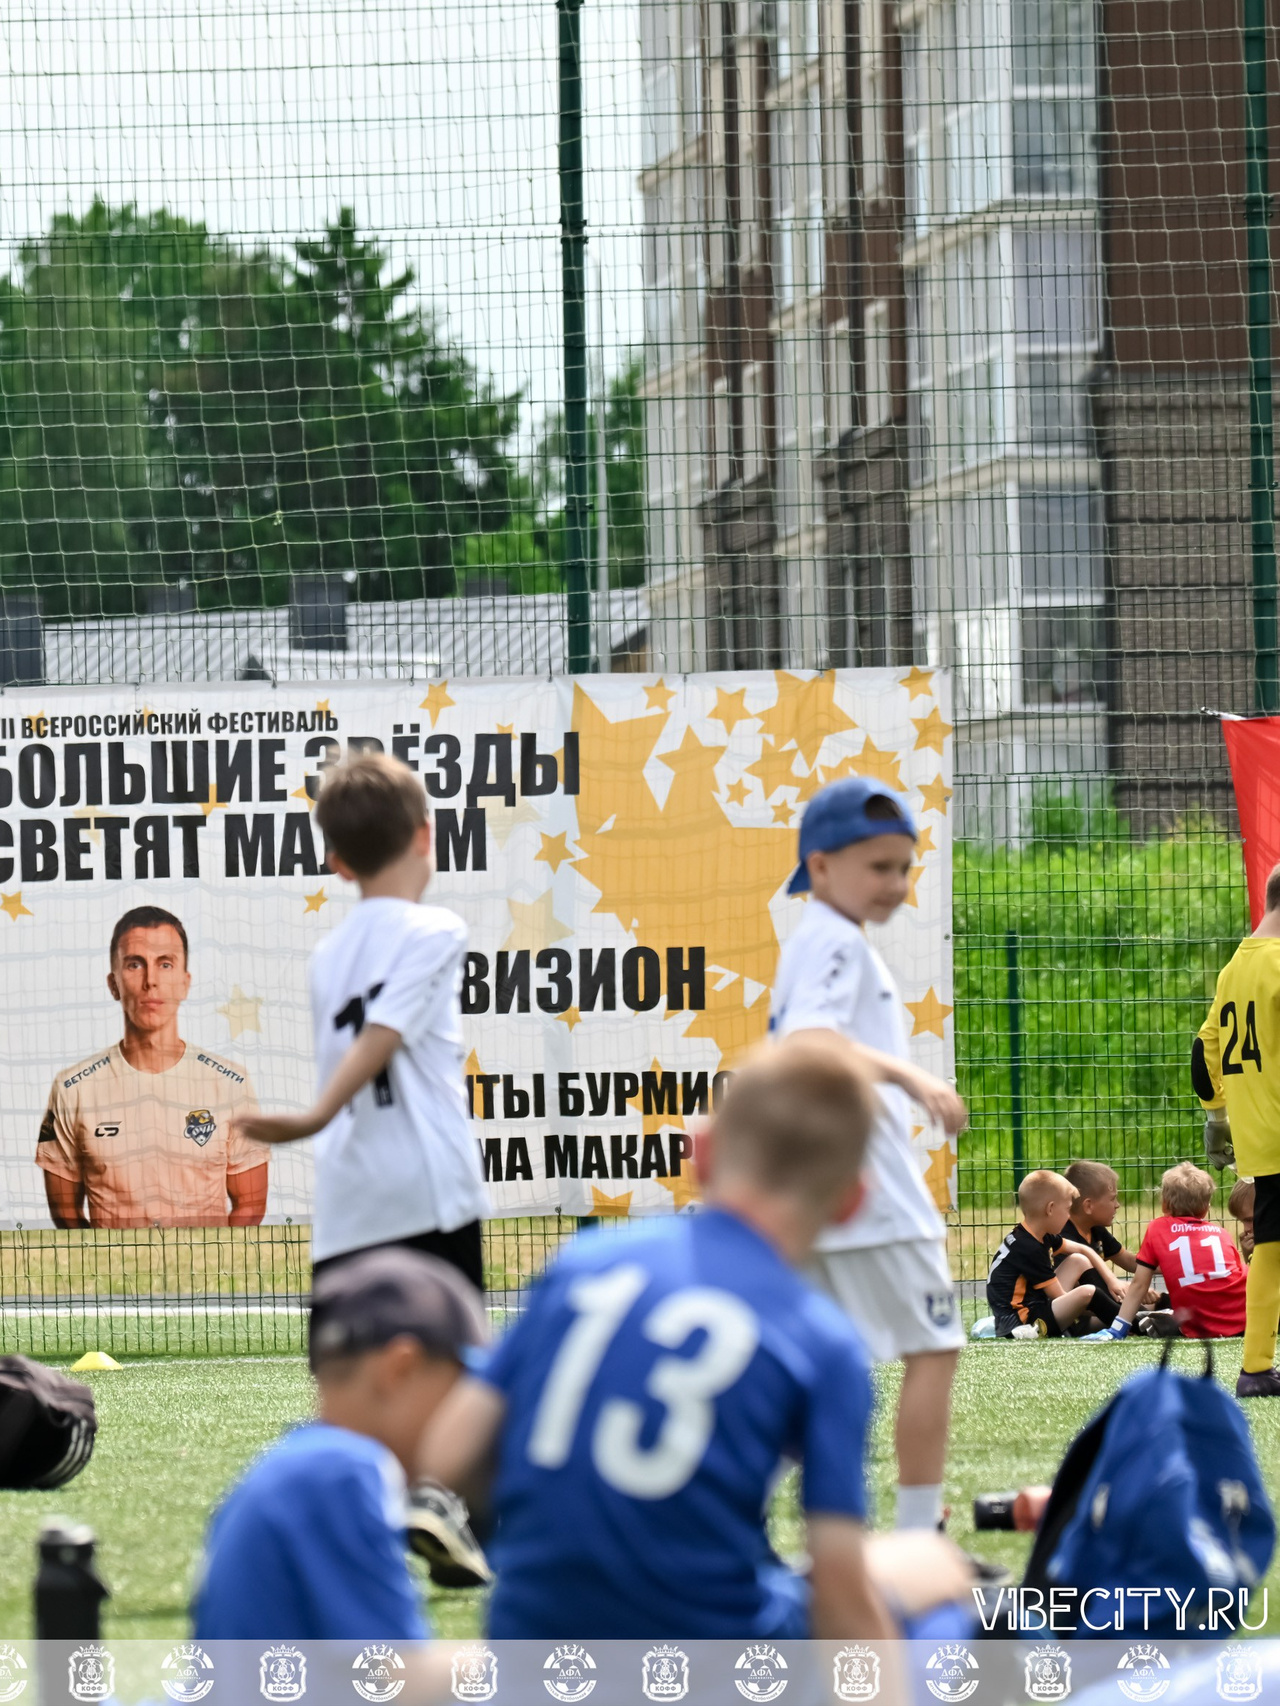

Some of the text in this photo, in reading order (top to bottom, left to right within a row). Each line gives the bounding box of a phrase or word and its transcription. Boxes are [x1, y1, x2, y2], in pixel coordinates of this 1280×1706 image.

[21, 709, 201, 738] ВСЕРОССИЙСКИЙ
[208, 710, 338, 734] ФЕСТИВАЛЬ
[224, 808, 487, 877] МАМ
[460, 945, 706, 1014] ВИЗИОН
[1220, 1001, 1262, 1075] 24
[64, 1056, 111, 1089] БЕТСИТИ
[197, 1053, 244, 1084] БЕТСИТИ
[544, 1134, 694, 1179] МАКАР
[1169, 1235, 1232, 1287] 11
[528, 1264, 759, 1500] 13
